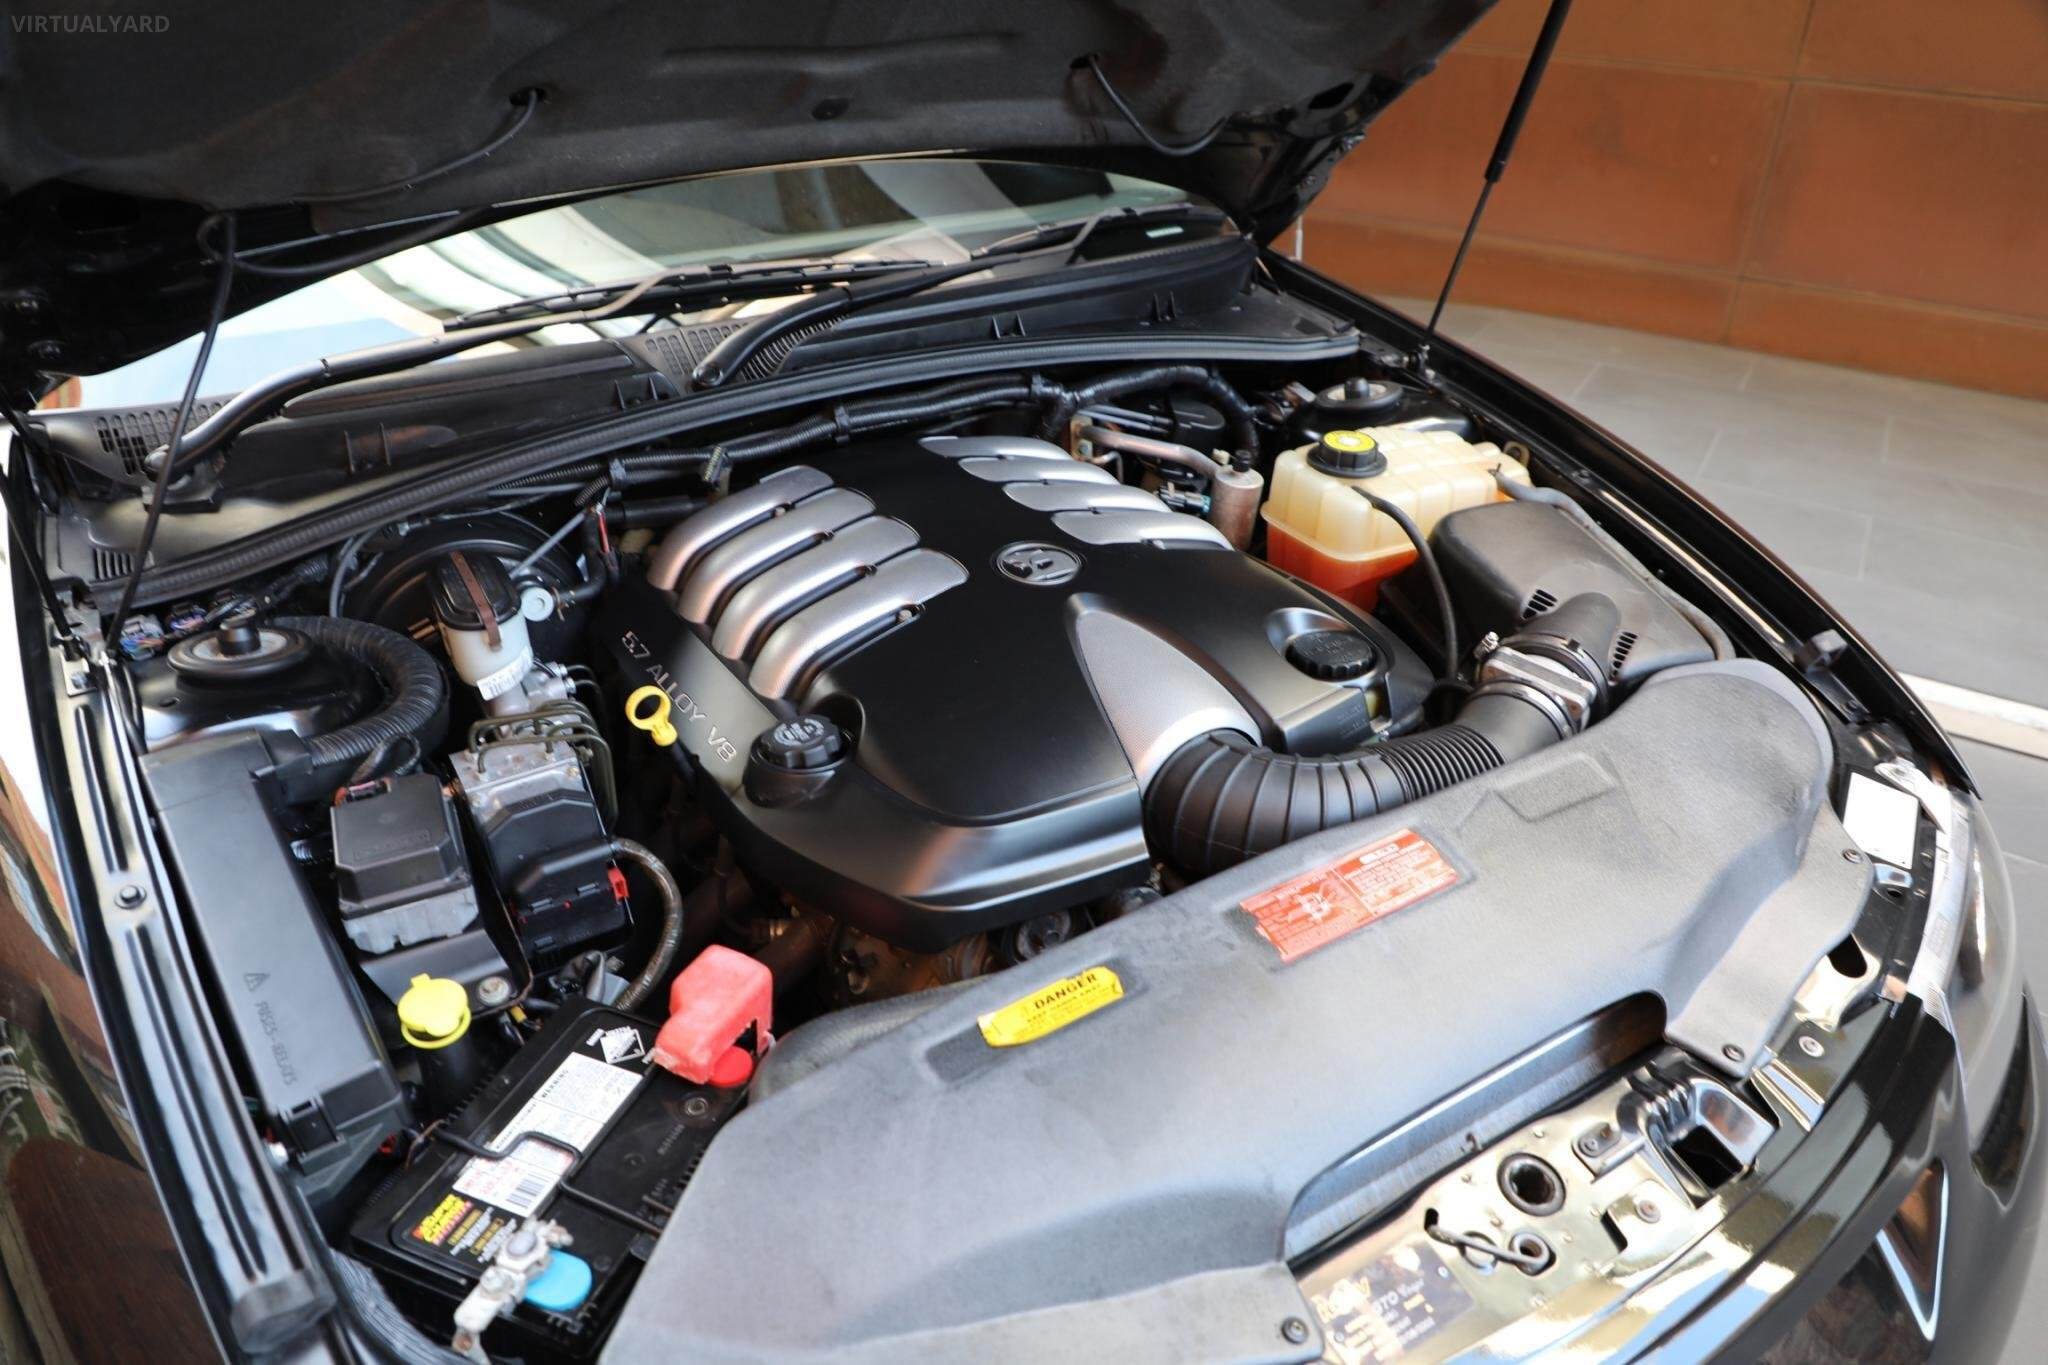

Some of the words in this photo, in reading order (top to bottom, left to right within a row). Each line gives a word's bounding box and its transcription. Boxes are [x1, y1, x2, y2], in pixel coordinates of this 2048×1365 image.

[646, 664, 707, 722] ALLOY
[708, 726, 737, 762] V8
[1034, 973, 1097, 1009] DANGER
